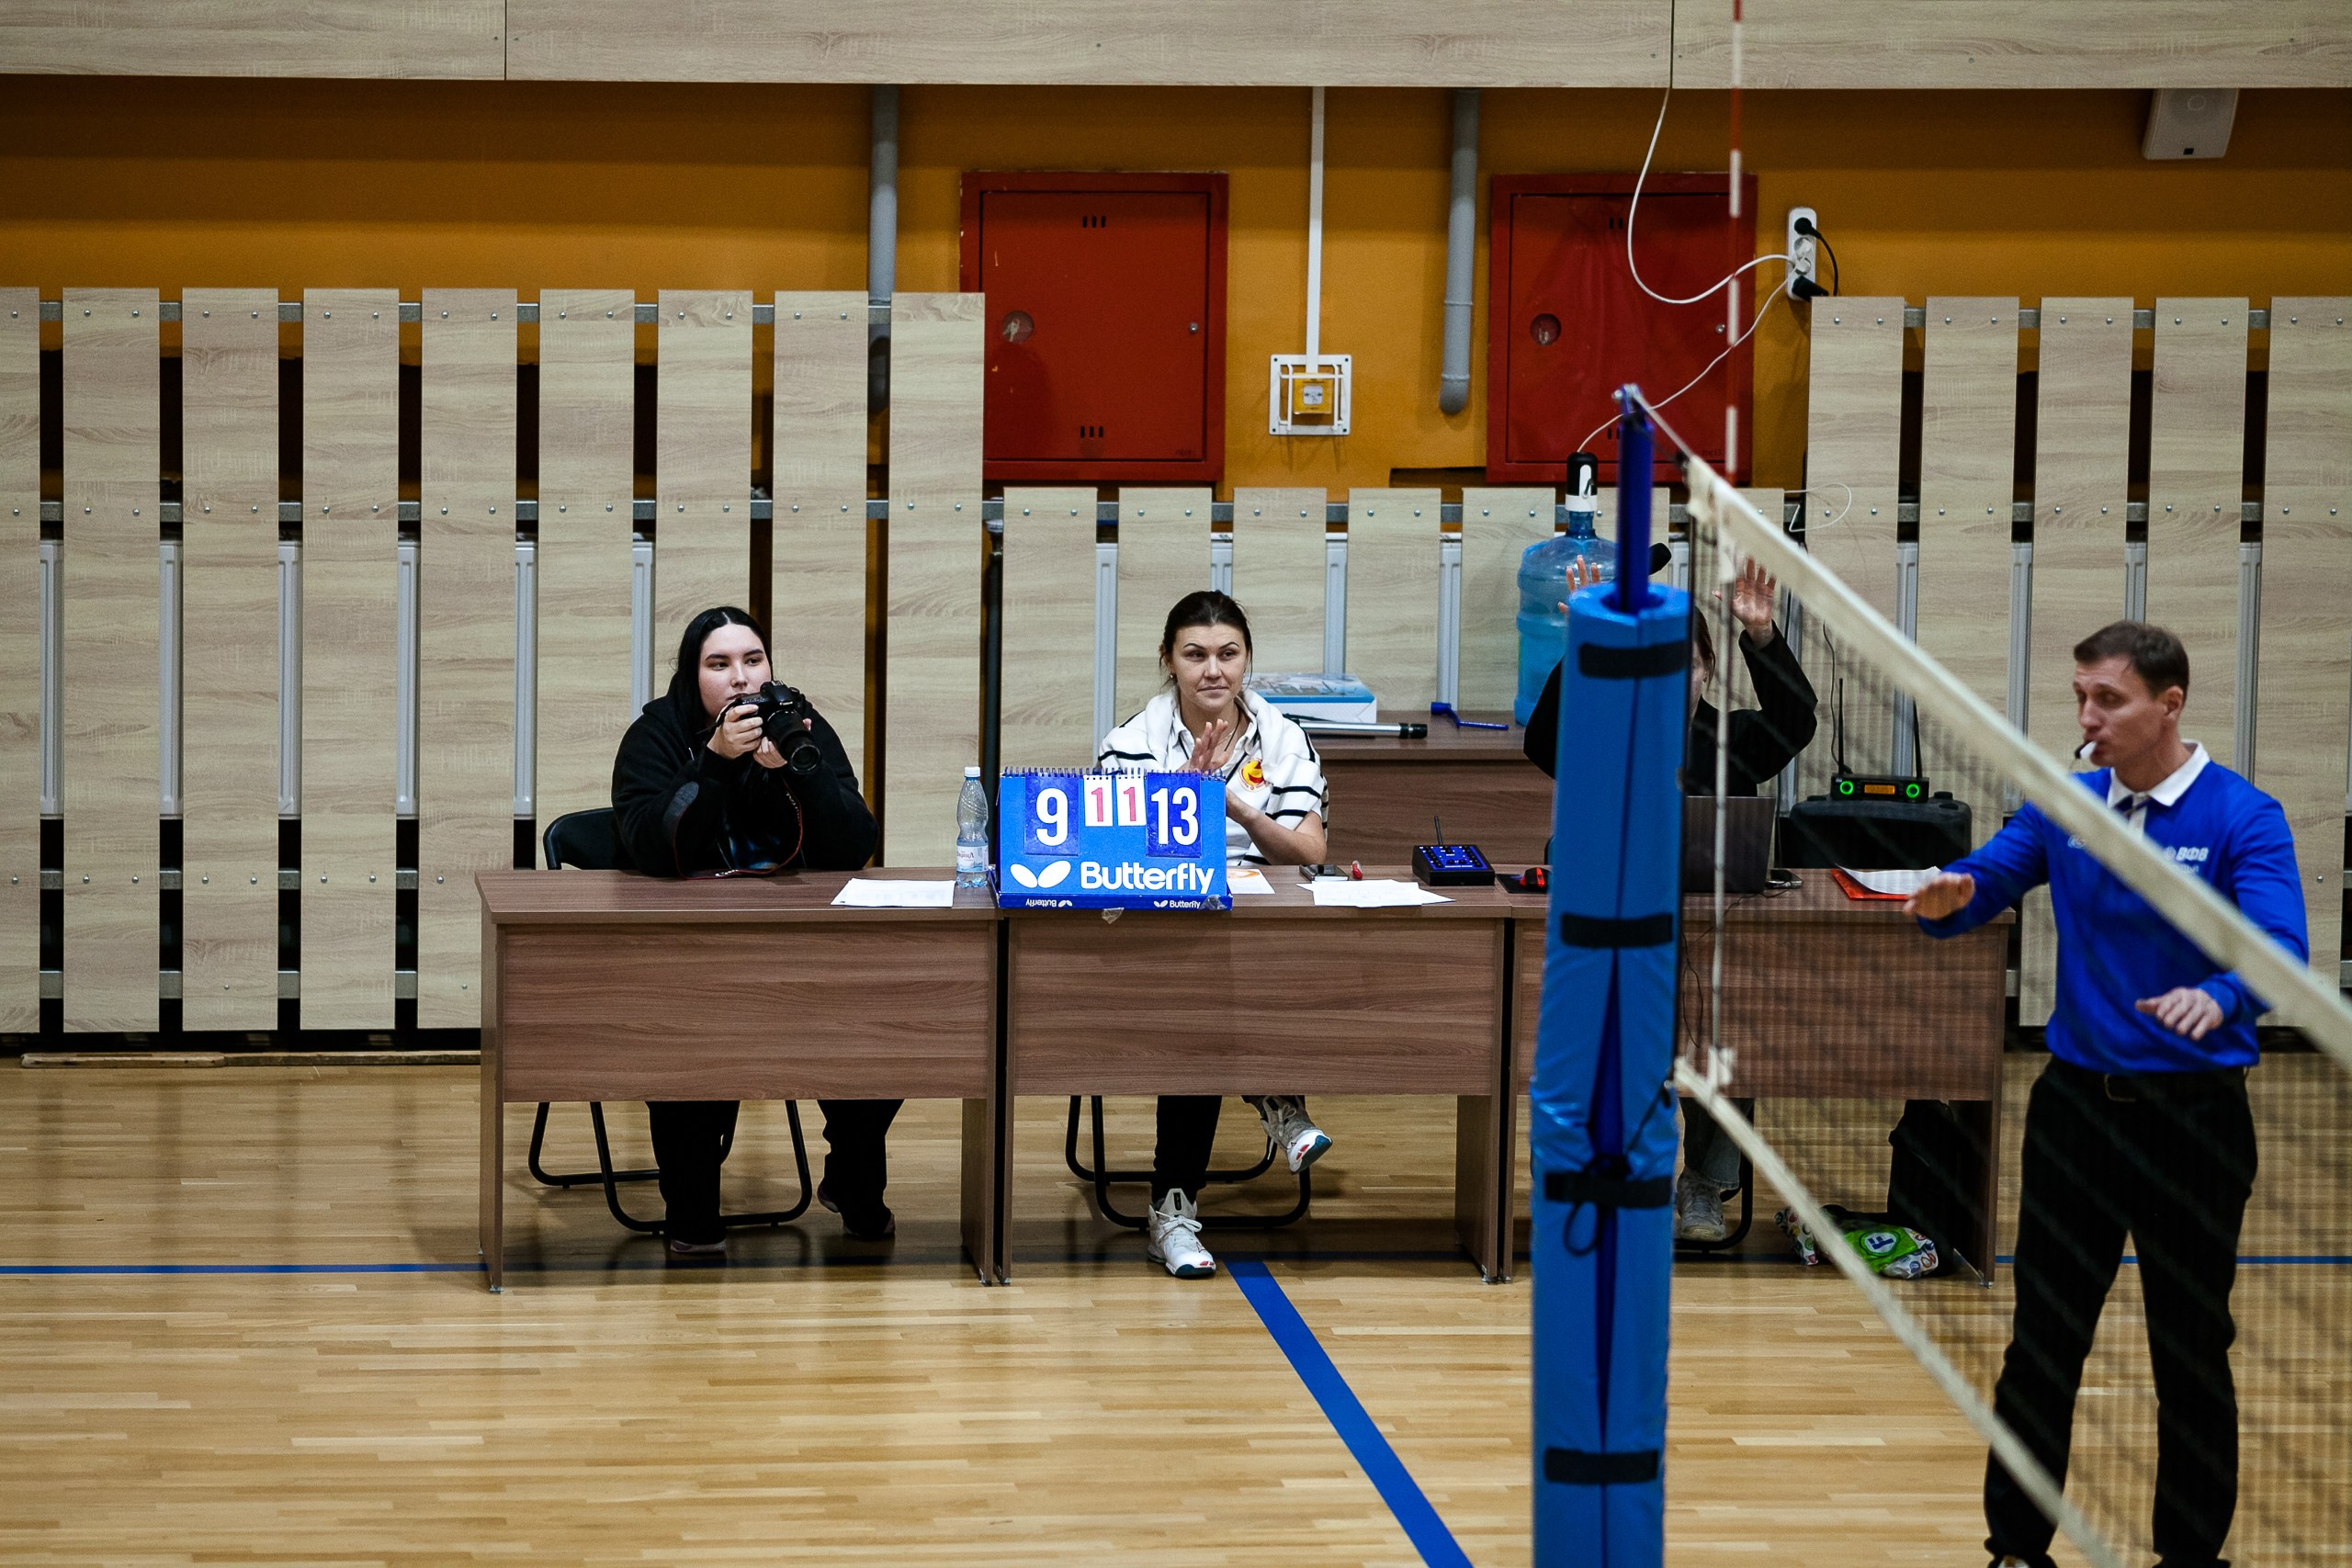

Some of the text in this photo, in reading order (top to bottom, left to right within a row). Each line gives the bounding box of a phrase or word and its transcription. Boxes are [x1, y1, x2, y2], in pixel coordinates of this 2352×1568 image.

[1035, 787, 1069, 847] 9
[1150, 786, 1199, 846] 13
[1080, 861, 1215, 895] Butterfly
[1025, 898, 1057, 908] Butterfly
[1169, 899, 1201, 909] Butterfly
